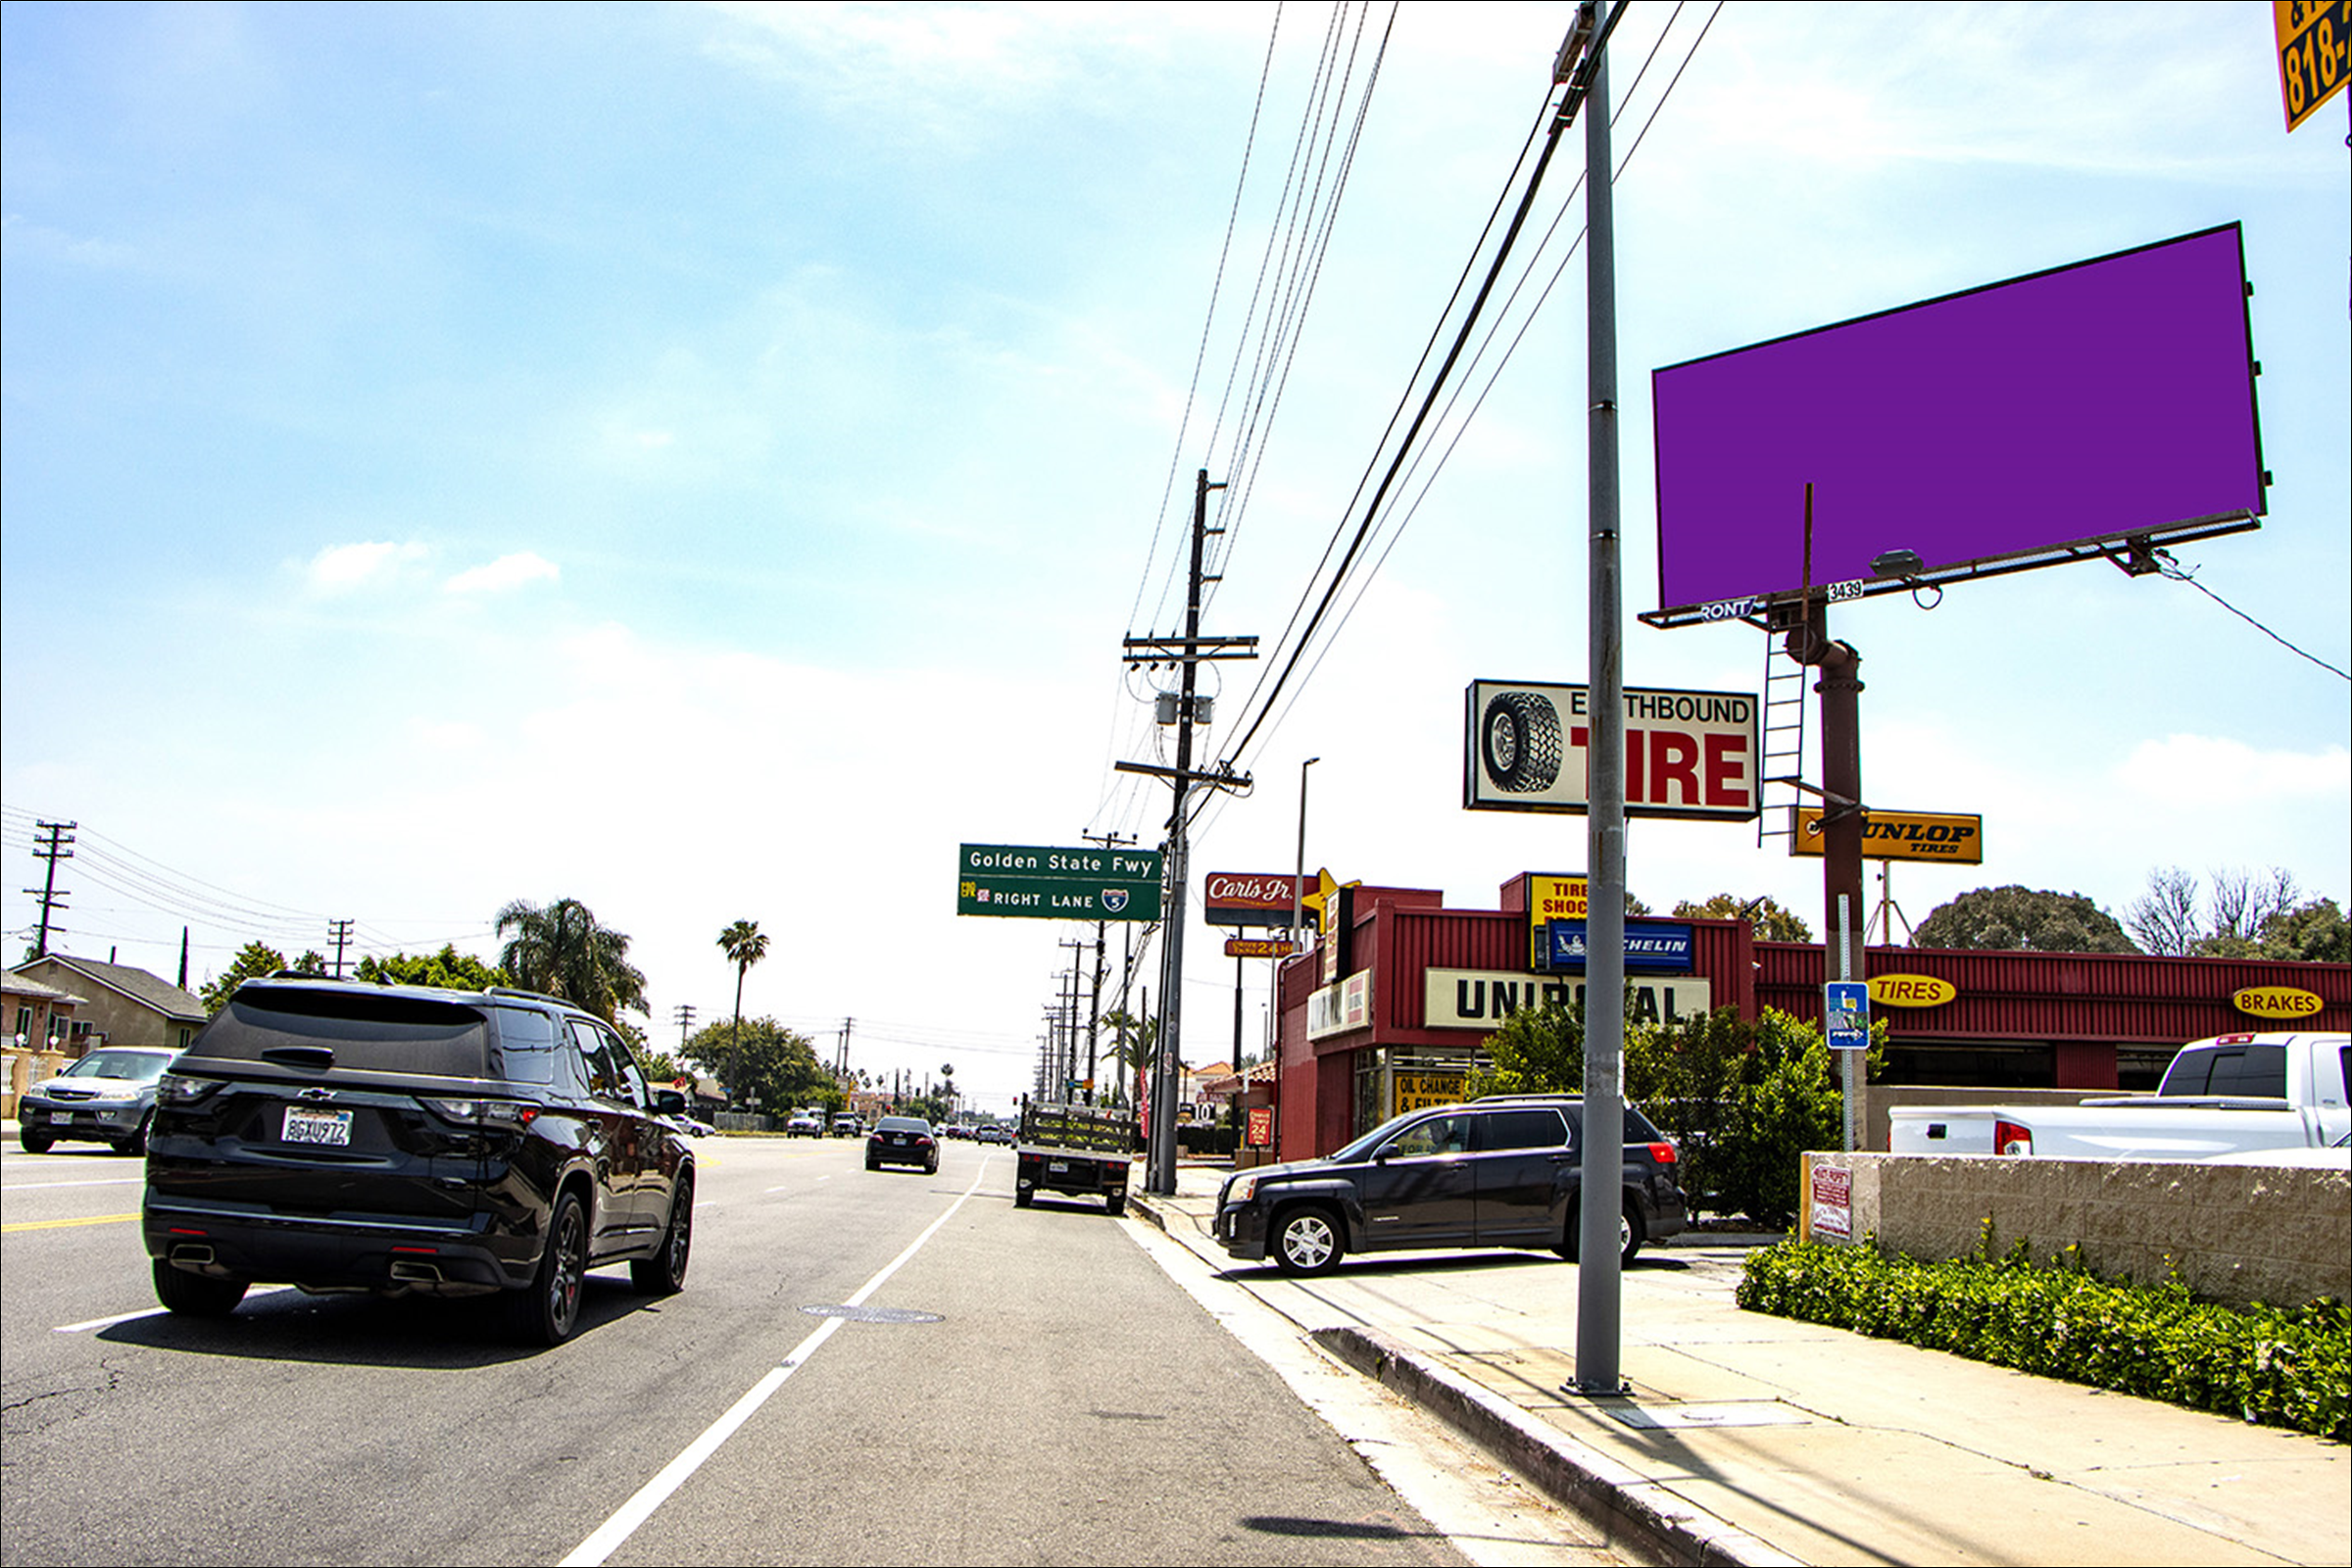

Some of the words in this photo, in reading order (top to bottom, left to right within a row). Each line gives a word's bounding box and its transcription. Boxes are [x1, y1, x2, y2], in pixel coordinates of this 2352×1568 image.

[1829, 581, 1862, 600] 3439
[1571, 691, 1750, 723] ETHBOUND
[1862, 821, 1976, 843] UNLOP
[1911, 843, 1959, 854] TIRES
[969, 852, 1038, 868] Golden
[1049, 855, 1102, 871] State
[1112, 858, 1152, 878] Fwy
[1209, 877, 1264, 900] Carl's
[1261, 879, 1294, 902] Jr.
[1552, 882, 1589, 897] TIRE
[994, 892, 1041, 906] RIGHT
[1052, 895, 1094, 907] LANE
[1111, 896, 1120, 907] 5
[1542, 899, 1589, 914] SHOC
[1623, 939, 1688, 952] HELIN
[1877, 981, 1941, 1001] TIRES
[1456, 979, 1685, 1026] UNIRAL
[2240, 994, 2316, 1011] BRAKES
[1400, 1078, 1415, 1094] OIL
[1420, 1079, 1460, 1095] CHANGE
[1400, 1098, 1409, 1113] &
[1251, 1124, 1266, 1135] 24
